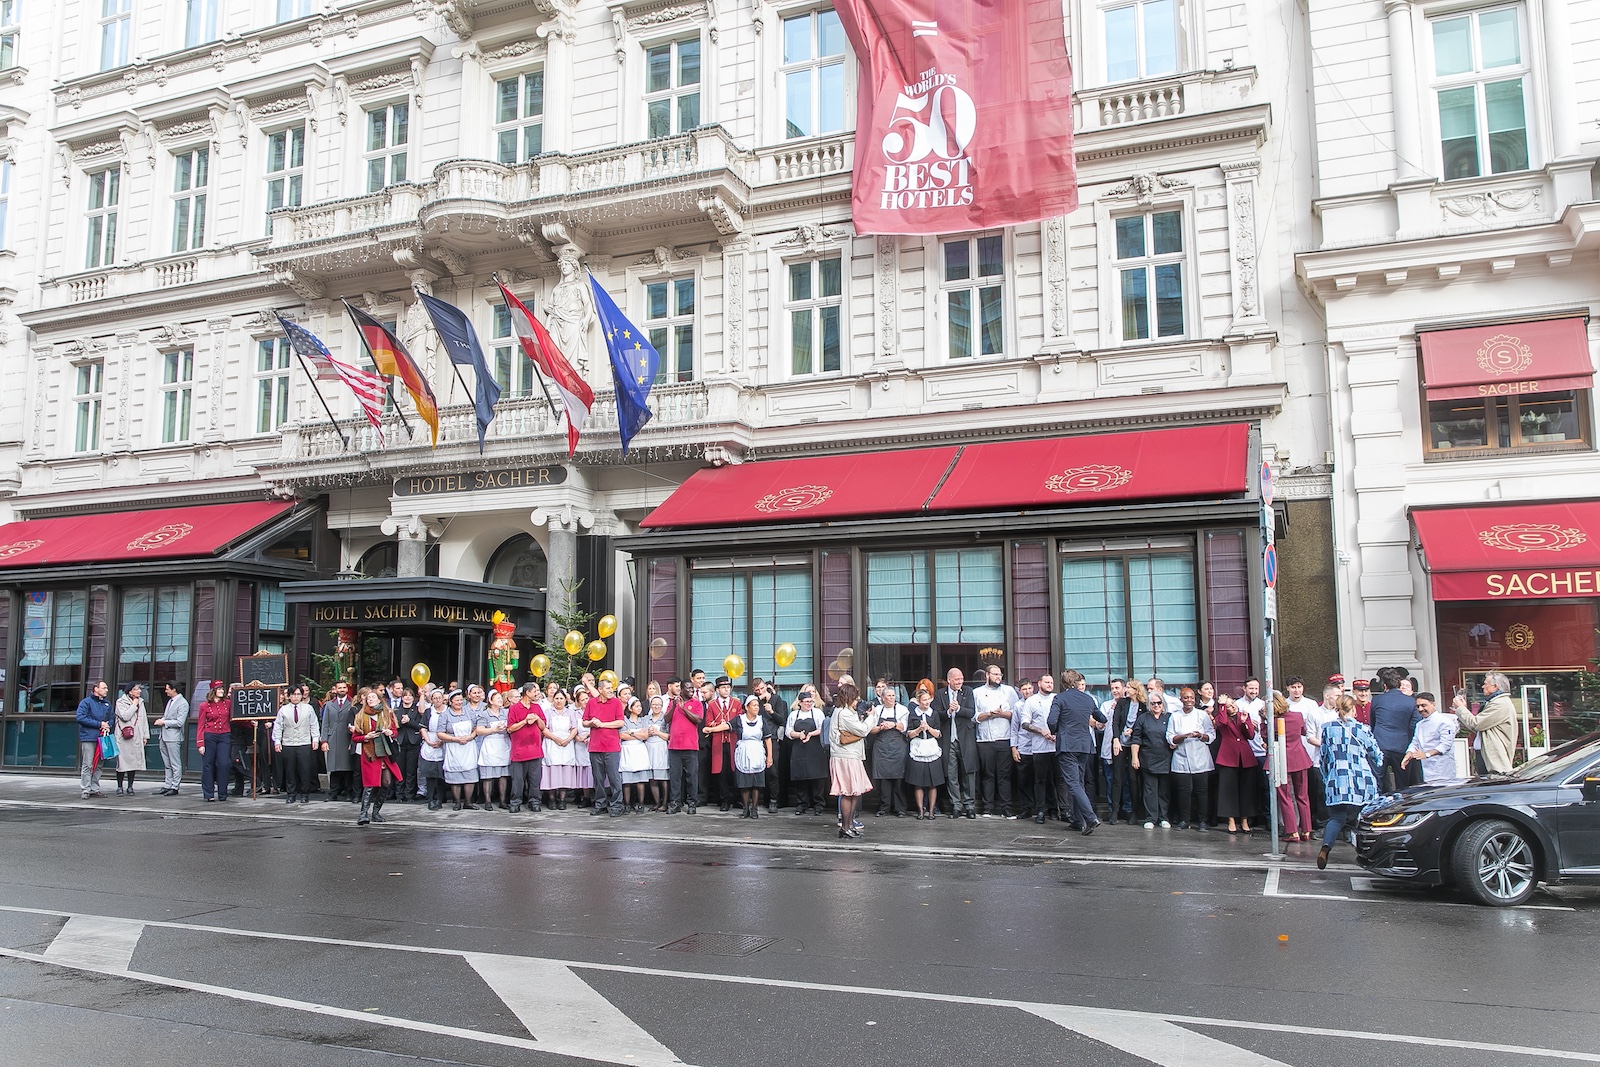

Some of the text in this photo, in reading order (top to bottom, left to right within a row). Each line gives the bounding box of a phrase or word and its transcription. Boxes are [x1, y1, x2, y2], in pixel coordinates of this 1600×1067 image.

[919, 67, 936, 80] THE
[903, 73, 957, 97] WORLD'S
[881, 85, 977, 165] 50
[881, 157, 972, 192] BEST
[879, 186, 974, 210] HOTELS
[1478, 381, 1539, 396] SACHER
[409, 468, 550, 494] HOTEL SACHER
[1486, 571, 1600, 596] SACHE
[315, 604, 417, 621] HOTEL SACHER
[433, 605, 469, 621] HOTEL
[251, 660, 278, 670] BEST
[250, 671, 284, 681] TEAM
[238, 690, 271, 702] BEST
[239, 702, 272, 714] TEAM
